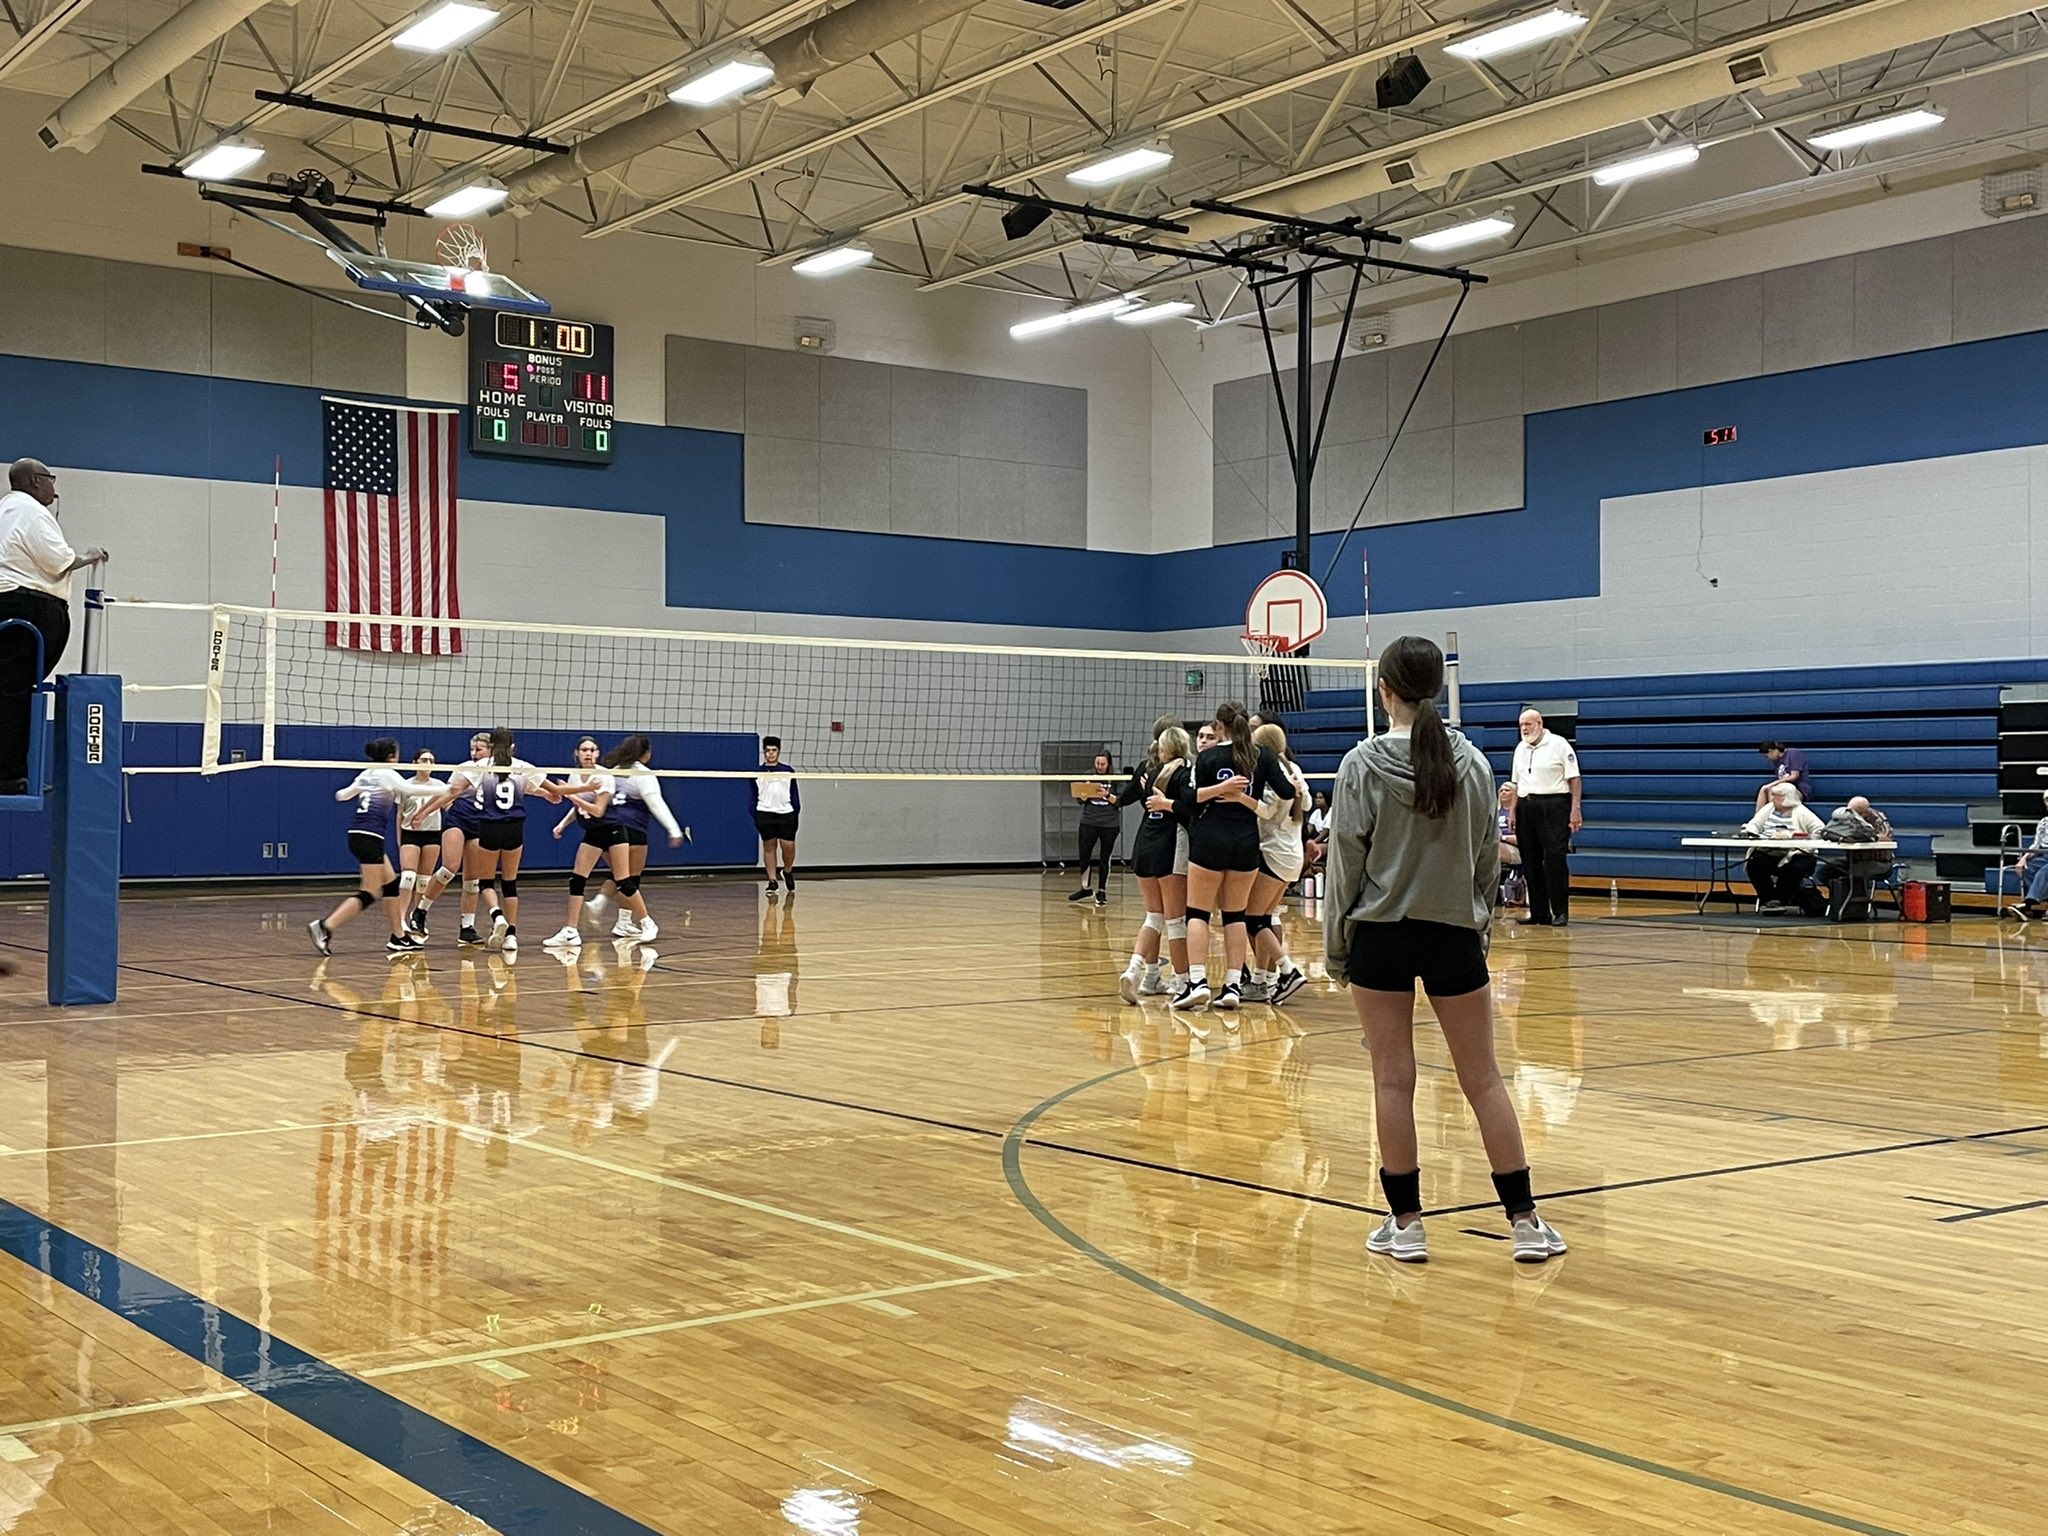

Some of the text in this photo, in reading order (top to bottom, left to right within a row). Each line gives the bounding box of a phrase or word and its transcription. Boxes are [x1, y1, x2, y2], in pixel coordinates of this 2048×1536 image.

[529, 320, 585, 353] 1:00
[528, 353, 563, 367] BONUS
[536, 365, 555, 375] POSS
[503, 363, 519, 390] 5
[529, 374, 562, 386] PERIOD
[584, 374, 608, 400] 11
[479, 389, 527, 407] HOME
[563, 399, 614, 417] VISITOR
[476, 405, 510, 418] FOULS
[526, 411, 564, 424] PLAYER
[493, 419, 506, 442] 0
[579, 417, 612, 430] FOULS
[595, 430, 608, 452] 0
[211, 630, 223, 671] PORTER
[89, 705, 101, 762] PORTER
[495, 780, 514, 810] 9
